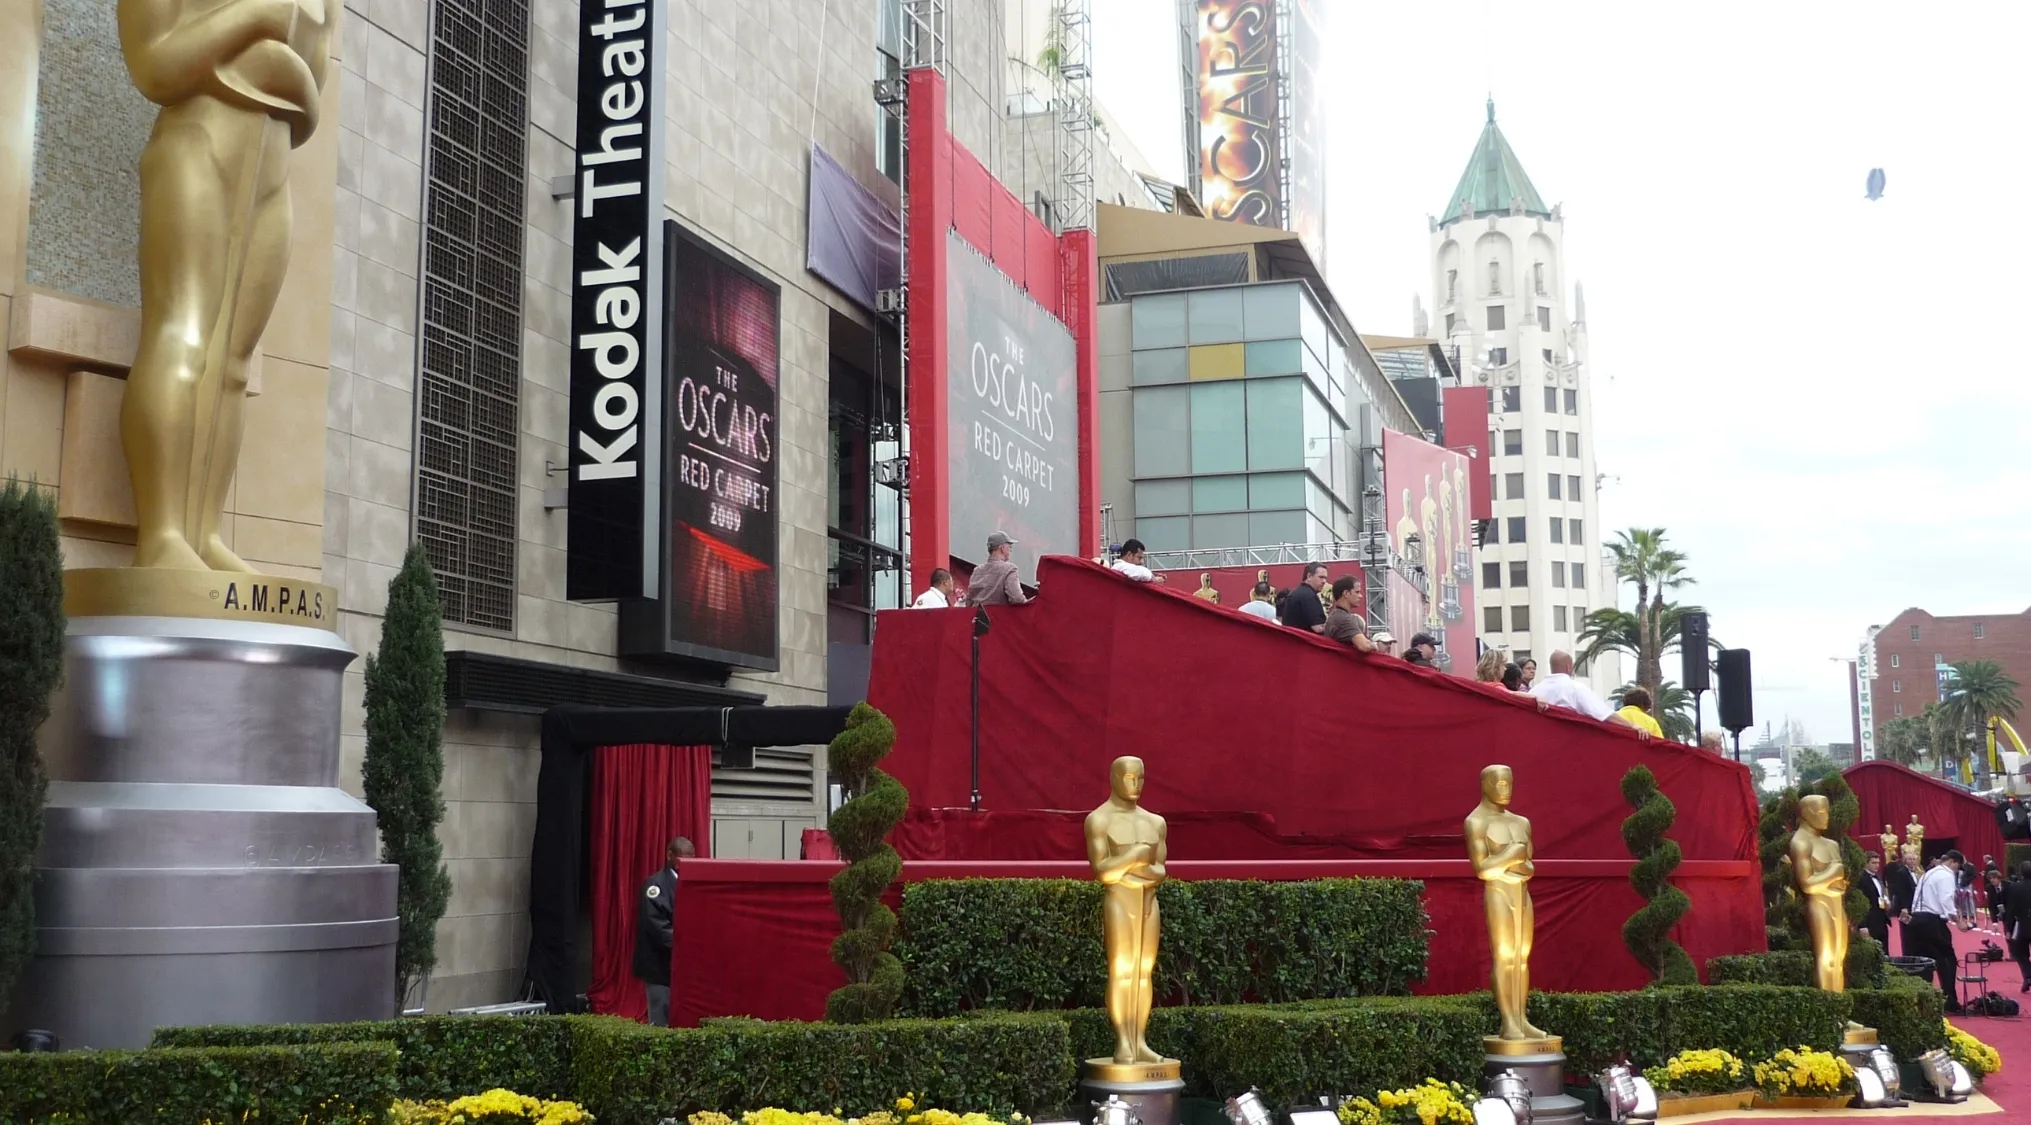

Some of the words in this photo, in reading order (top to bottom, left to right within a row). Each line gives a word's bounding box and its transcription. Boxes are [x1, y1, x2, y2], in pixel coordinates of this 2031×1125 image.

[578, 235, 641, 481] Kodak
[1004, 336, 1024, 365] THE
[716, 366, 738, 392] THE
[971, 341, 1054, 442] OSCARS
[678, 377, 771, 463] OSCARS
[974, 420, 1001, 461] RED
[1006, 441, 1054, 492] CARPET
[680, 453, 710, 491] RED
[715, 468, 770, 512] CARPET
[1002, 475, 1030, 508] 2009
[710, 502, 742, 532] 2009
[224, 582, 325, 620] A.M.P.A.S.
